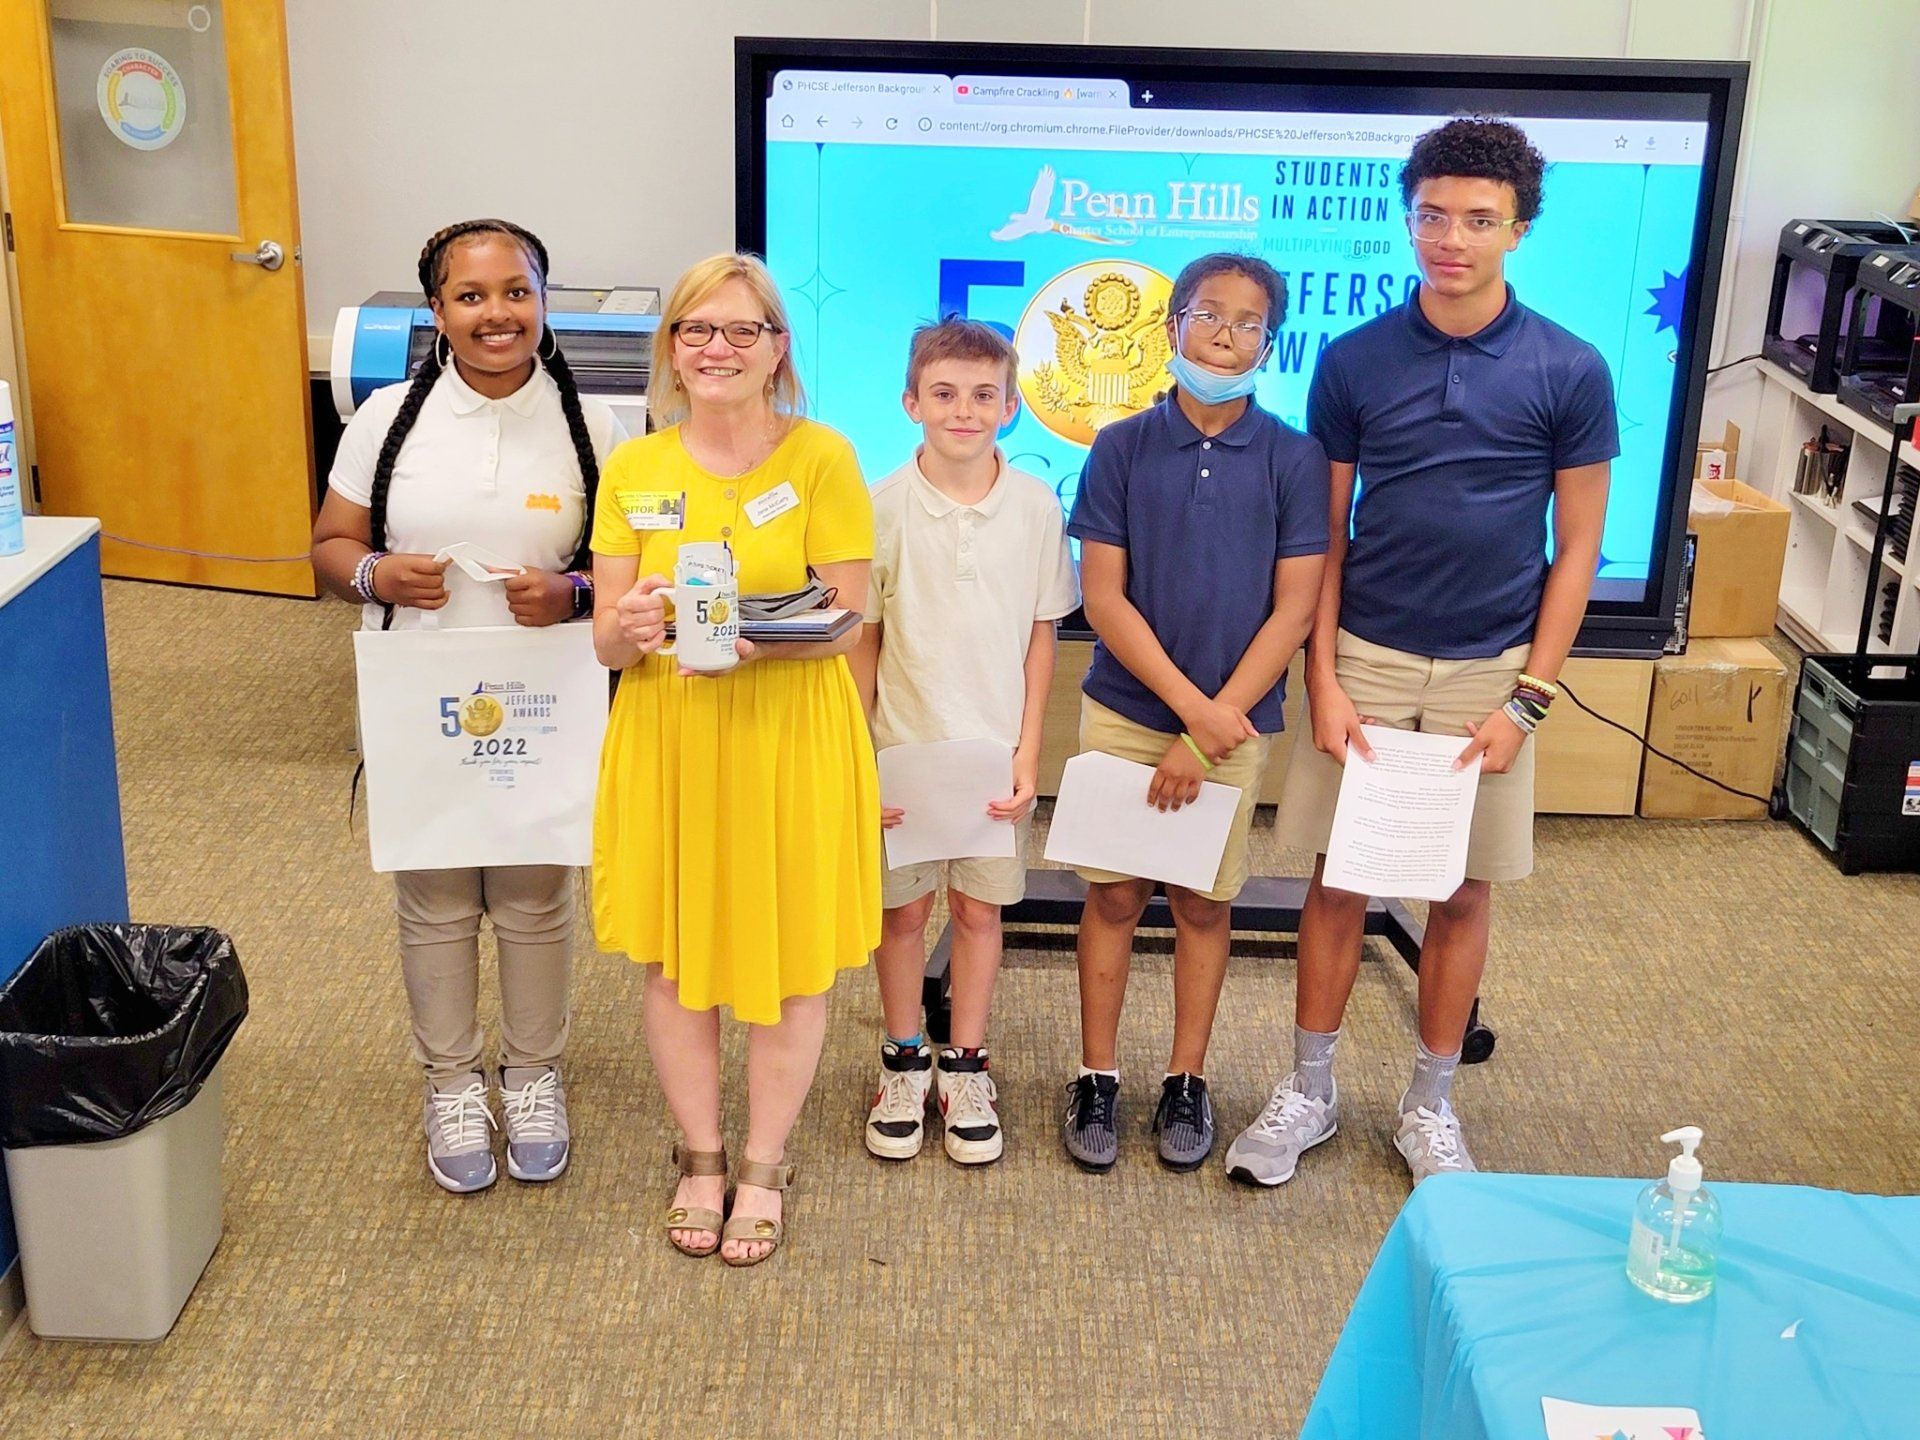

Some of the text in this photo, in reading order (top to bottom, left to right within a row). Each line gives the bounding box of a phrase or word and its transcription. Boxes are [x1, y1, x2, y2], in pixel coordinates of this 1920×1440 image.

[797, 81, 830, 91] PHCSE
[832, 82, 876, 93] Jefferson
[972, 86, 1013, 97] Campfire
[1016, 87, 1060, 99] Crackling
[1275, 160, 1391, 188] STUDENTS
[1060, 179, 1259, 223] Penn Hills
[1272, 194, 1389, 222] IN ACTION
[623, 505, 655, 515] SITOR
[505, 694, 557, 706] JEFFERSON
[512, 707, 551, 718] AWARDS
[473, 738, 527, 757] 2022
